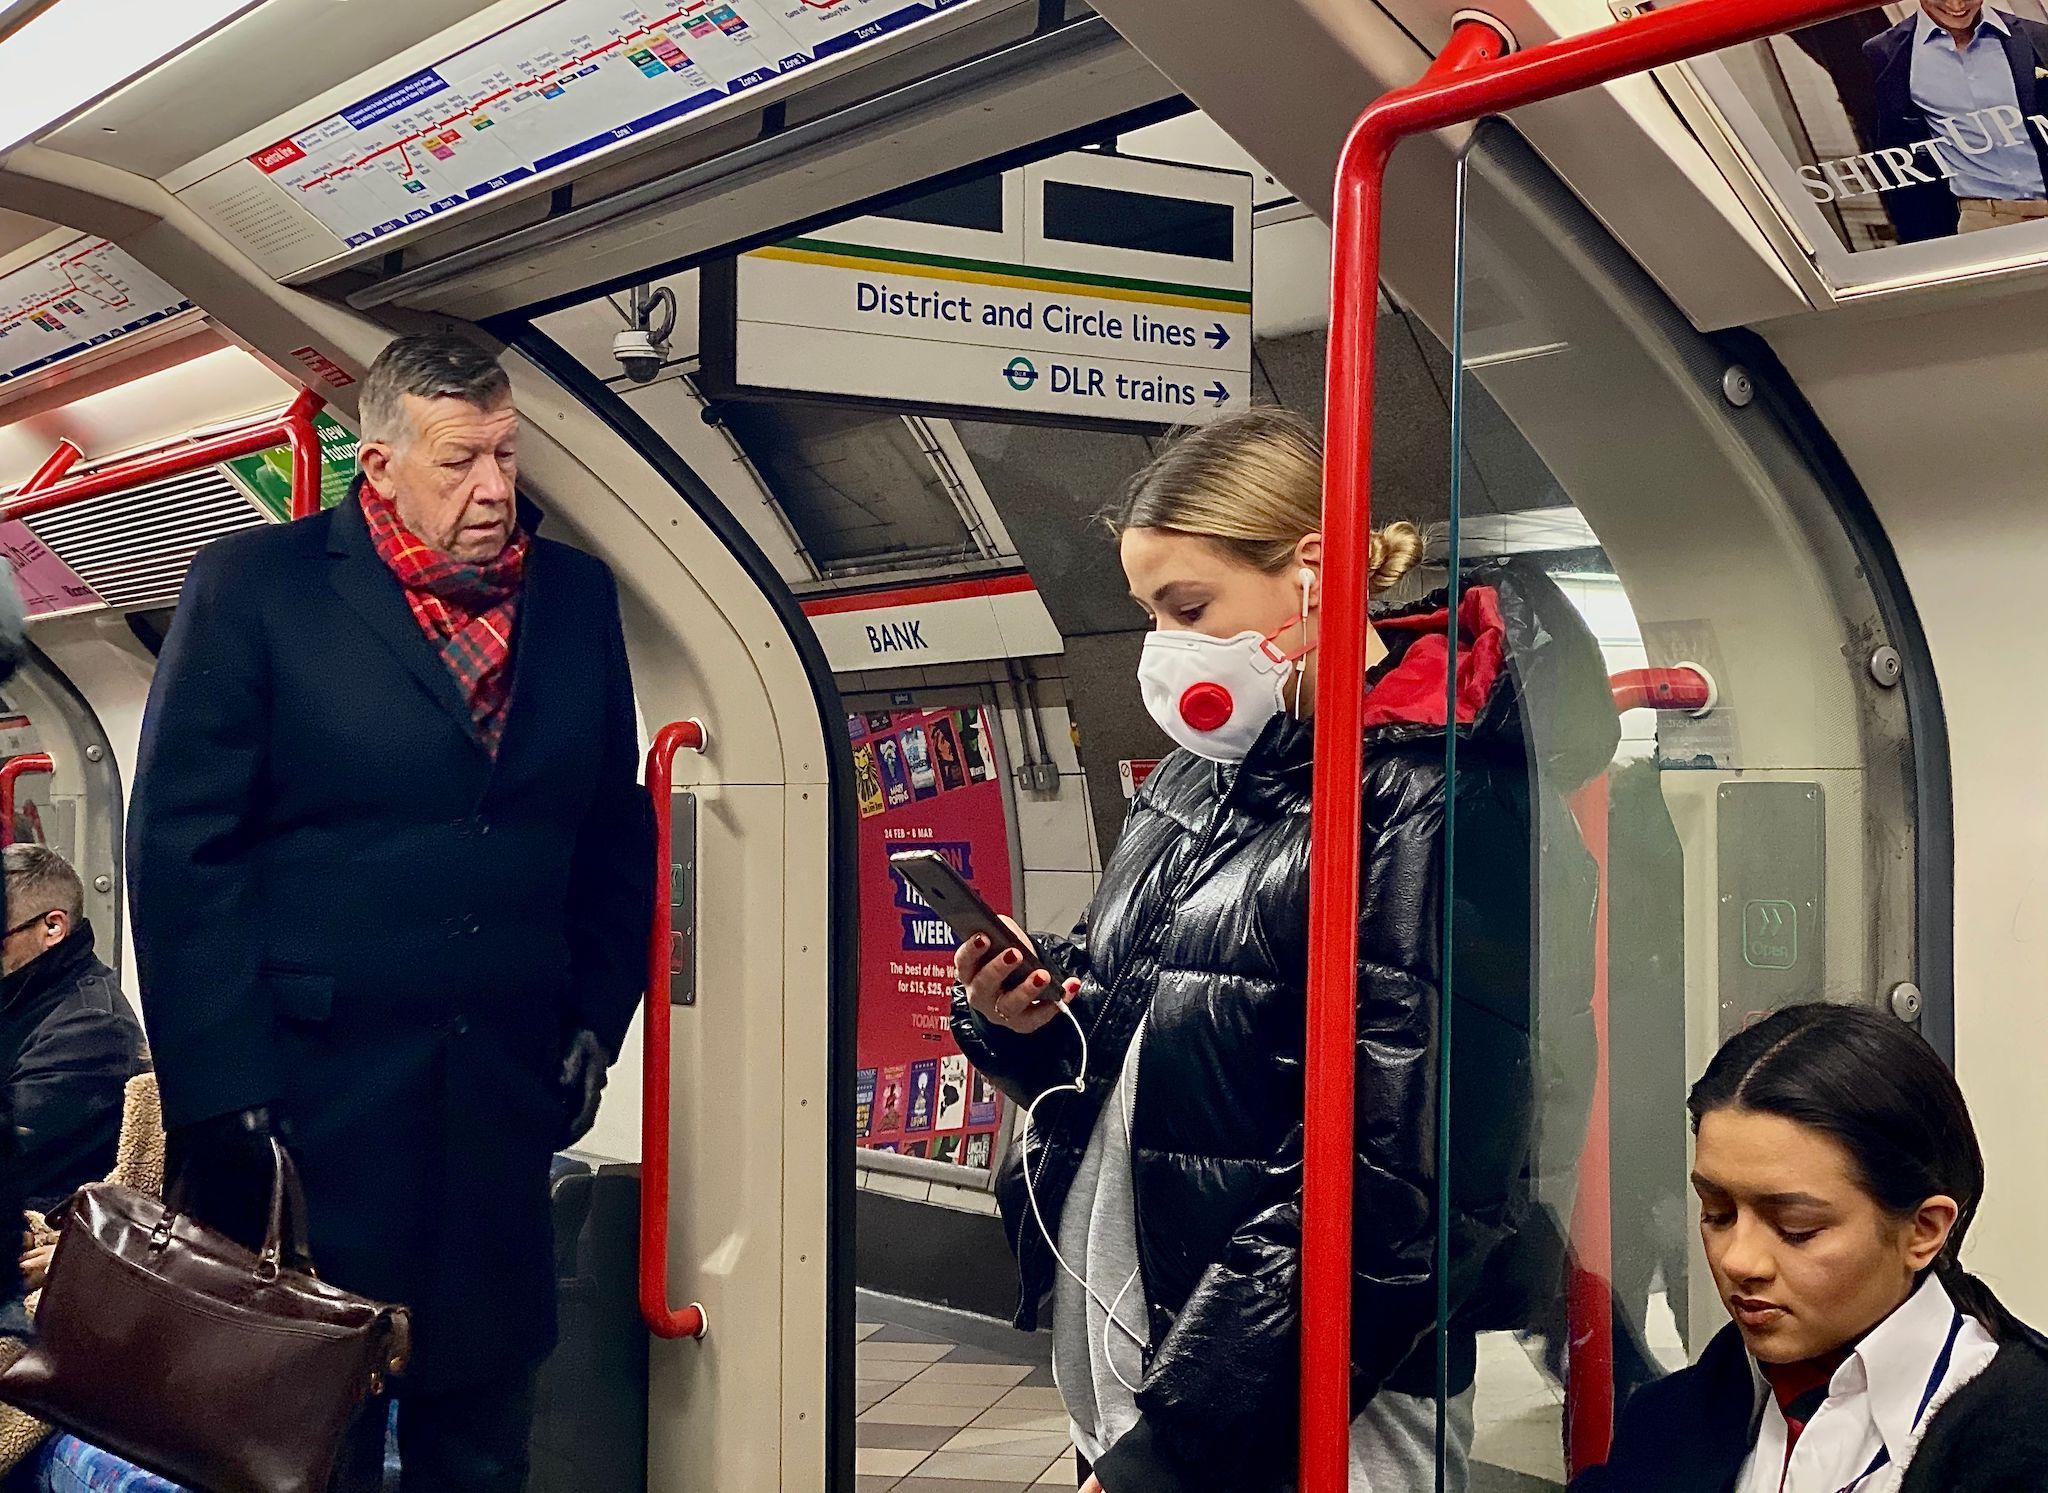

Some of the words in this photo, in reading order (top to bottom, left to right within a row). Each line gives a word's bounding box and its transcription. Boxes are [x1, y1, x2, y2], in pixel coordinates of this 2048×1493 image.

[854, 27, 877, 39] Zone
[780, 58, 802, 70] Zone
[737, 75, 758, 87] Zone
[611, 128, 631, 138] Zone
[257, 149, 286, 167] Central
[275, 146, 296, 158] line
[1796, 136, 1959, 205] SHIRT
[1936, 105, 2025, 155] UP
[857, 282, 972, 323] District
[982, 302, 1032, 329] and
[1042, 304, 1122, 339] Circle
[1133, 313, 1196, 347] lines
[1051, 364, 1106, 397] DLR
[1116, 374, 1195, 406] trains
[317, 424, 347, 443] view
[866, 620, 929, 654] BANK
[884, 828, 893, 839] 24
[893, 829, 905, 839] FEB
[918, 828, 933, 838] MAR
[912, 920, 955, 945] WEEK
[890, 962, 903, 974] The
[905, 962, 922, 976] best
[923, 964, 931, 976] of
[932, 964, 945, 978] the
[898, 980, 909, 992] for
[910, 981, 926, 997] £15,
[927, 981, 944, 998] £25,
